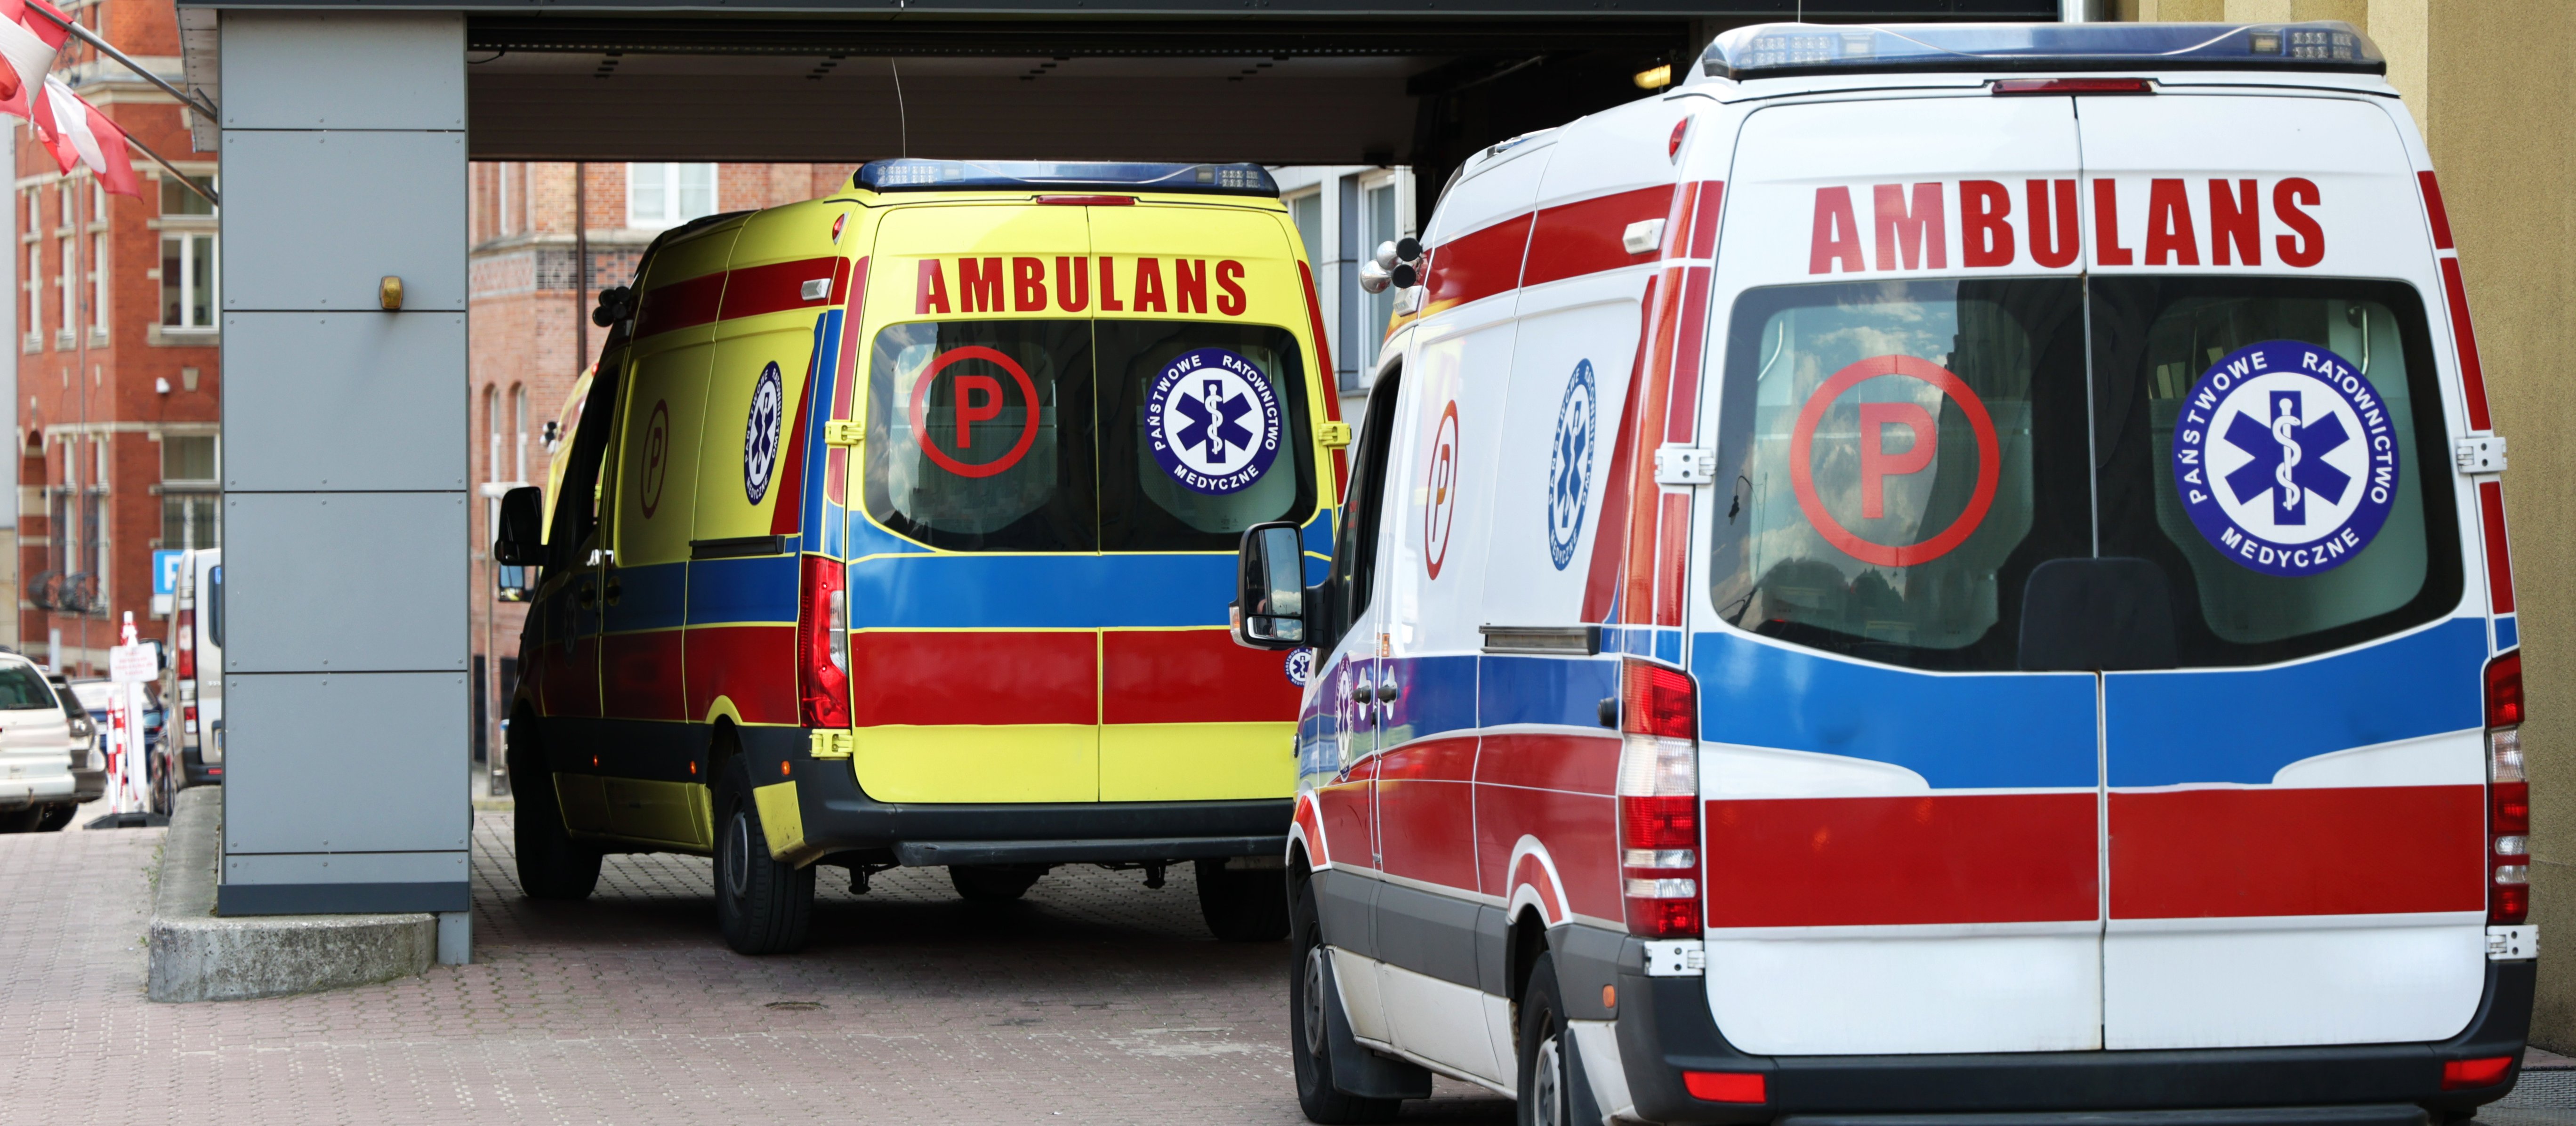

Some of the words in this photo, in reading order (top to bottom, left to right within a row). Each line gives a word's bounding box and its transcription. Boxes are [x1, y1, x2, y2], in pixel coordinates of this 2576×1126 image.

[1809, 177, 2325, 274] AMBULANS
[915, 256, 1247, 316] AMBULANS
[955, 375, 1004, 448] P
[1147, 355, 1201, 450] PAŃSTWOWE
[1223, 355, 1278, 450] RATOWNICTWO
[2178, 351, 2268, 504] PAŃSTWOWE
[2302, 352, 2392, 504] RATOWNICTWO
[647, 426, 662, 493] P
[746, 475, 768, 499] MEDYCZNE
[1174, 465, 1259, 490] MEDYCZNE
[1432, 443, 1450, 542] P
[1859, 402, 1937, 519] P
[1549, 529, 1578, 565] MEDYCZNE
[2221, 528, 2359, 567] MEDYCZNE
